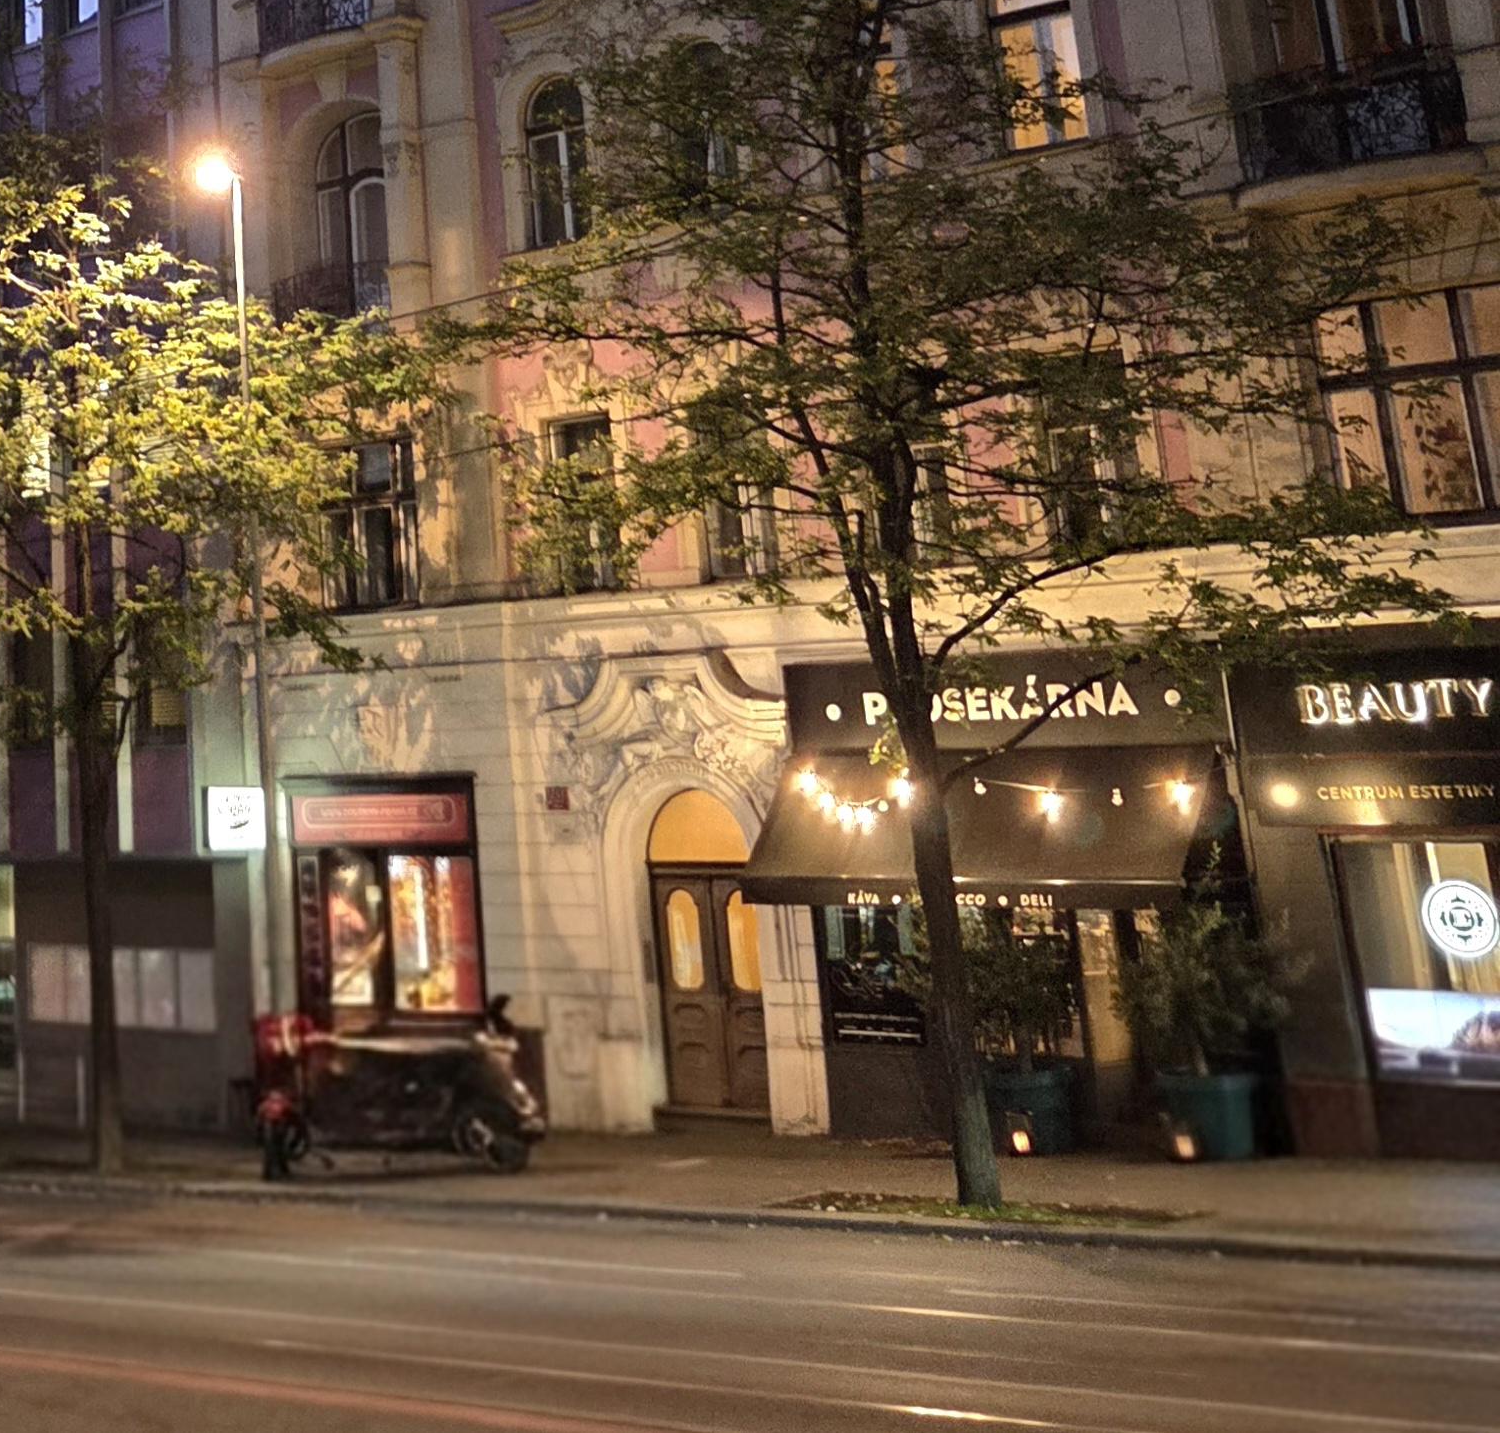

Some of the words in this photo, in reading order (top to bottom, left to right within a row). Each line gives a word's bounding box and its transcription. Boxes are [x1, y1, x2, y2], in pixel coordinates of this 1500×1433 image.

[861, 674, 1140, 725] PSEKÁRNA
[1295, 677, 1493, 725] BEAUTY
[1316, 785, 1404, 801] CENTRUM
[1409, 784, 1495, 799] ESTETIKY
[847, 889, 880, 905] KÁVA
[1020, 893, 1053, 907] DELI
